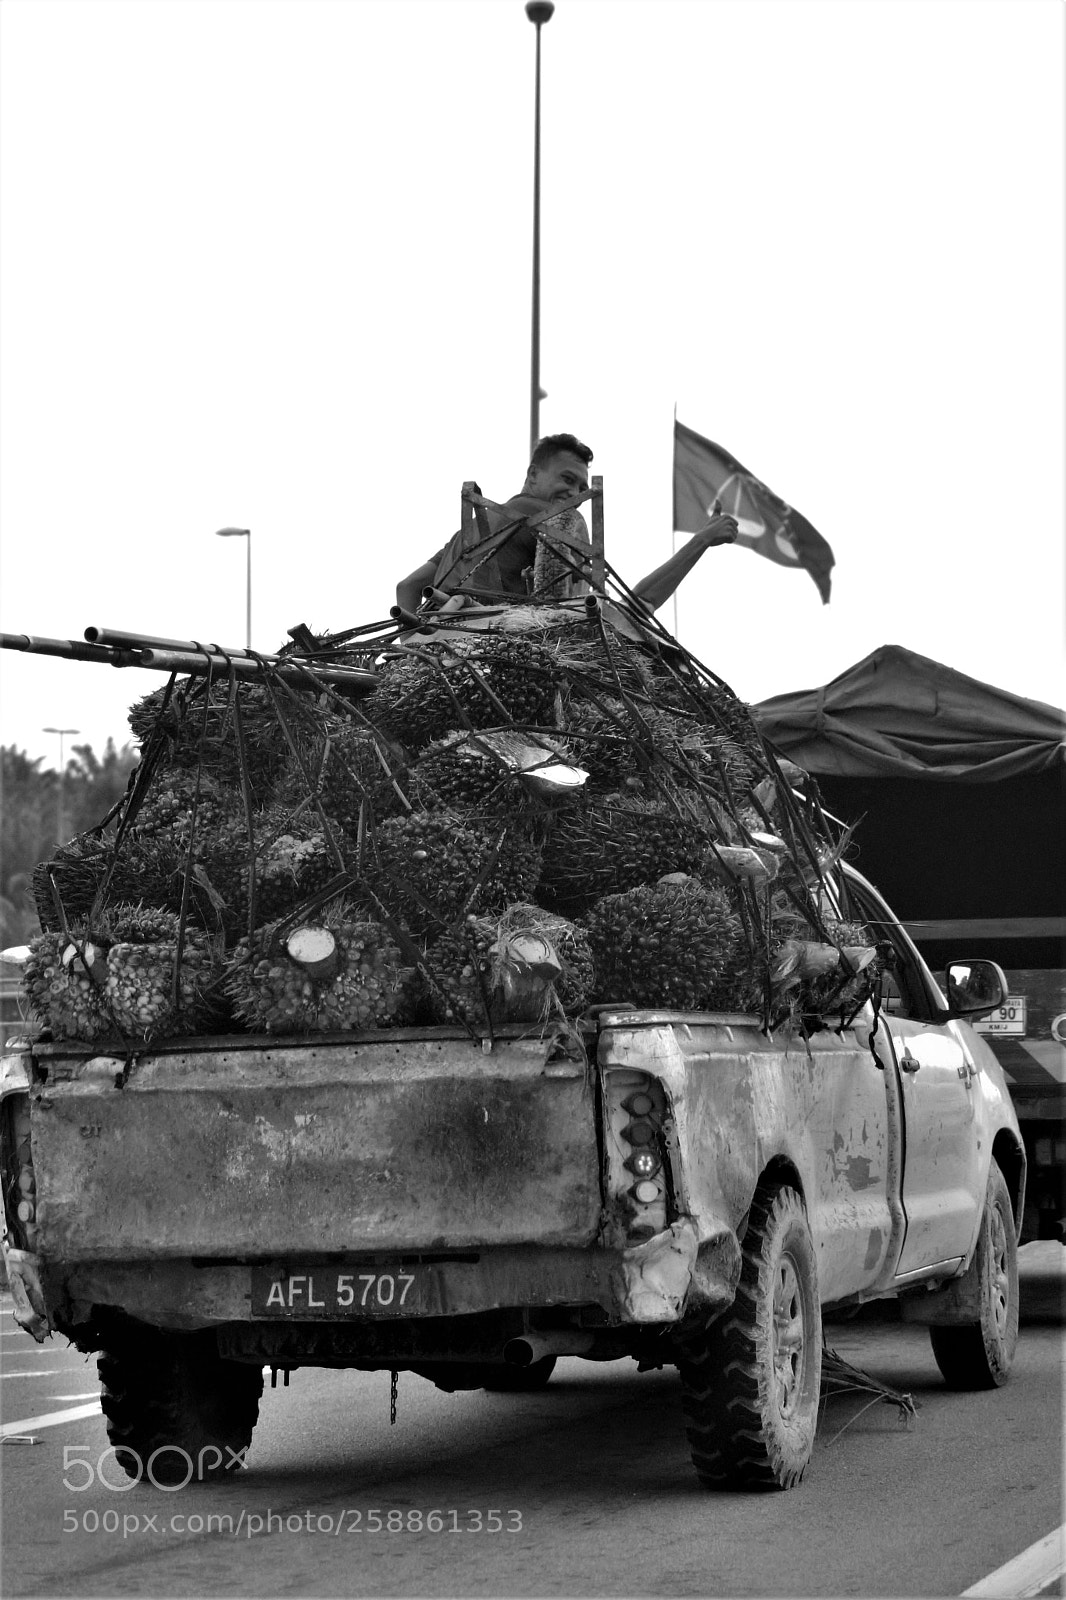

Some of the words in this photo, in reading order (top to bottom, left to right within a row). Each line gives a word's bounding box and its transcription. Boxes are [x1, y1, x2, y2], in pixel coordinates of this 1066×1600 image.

[1000, 1007, 1016, 1020] 90
[266, 1276, 325, 1307] AFL
[336, 1274, 415, 1306] 5707
